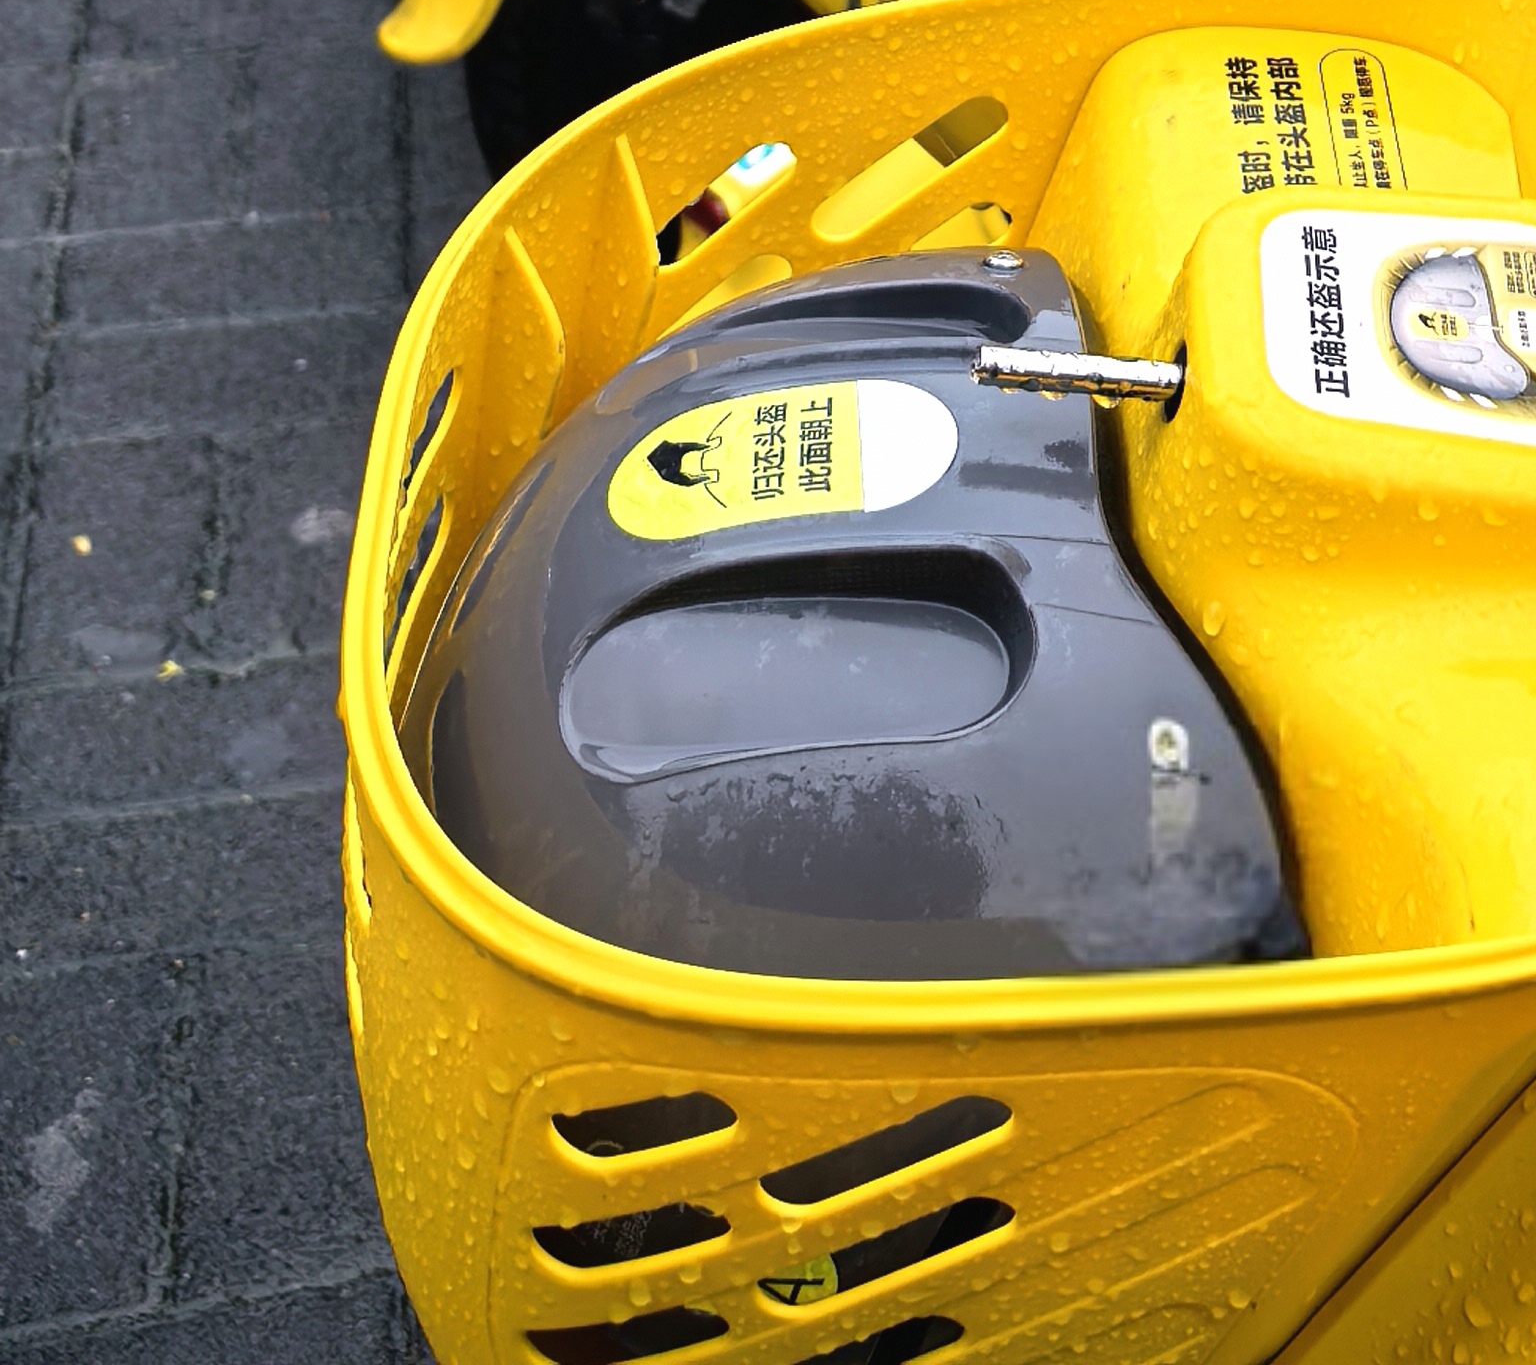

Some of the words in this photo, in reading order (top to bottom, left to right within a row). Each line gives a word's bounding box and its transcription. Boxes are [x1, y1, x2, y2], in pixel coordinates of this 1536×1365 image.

[1301, 225, 1351, 399] 正确还盔示意
[751, 402, 788, 501] 归还头盔
[798, 396, 833, 494] 此面朝上
